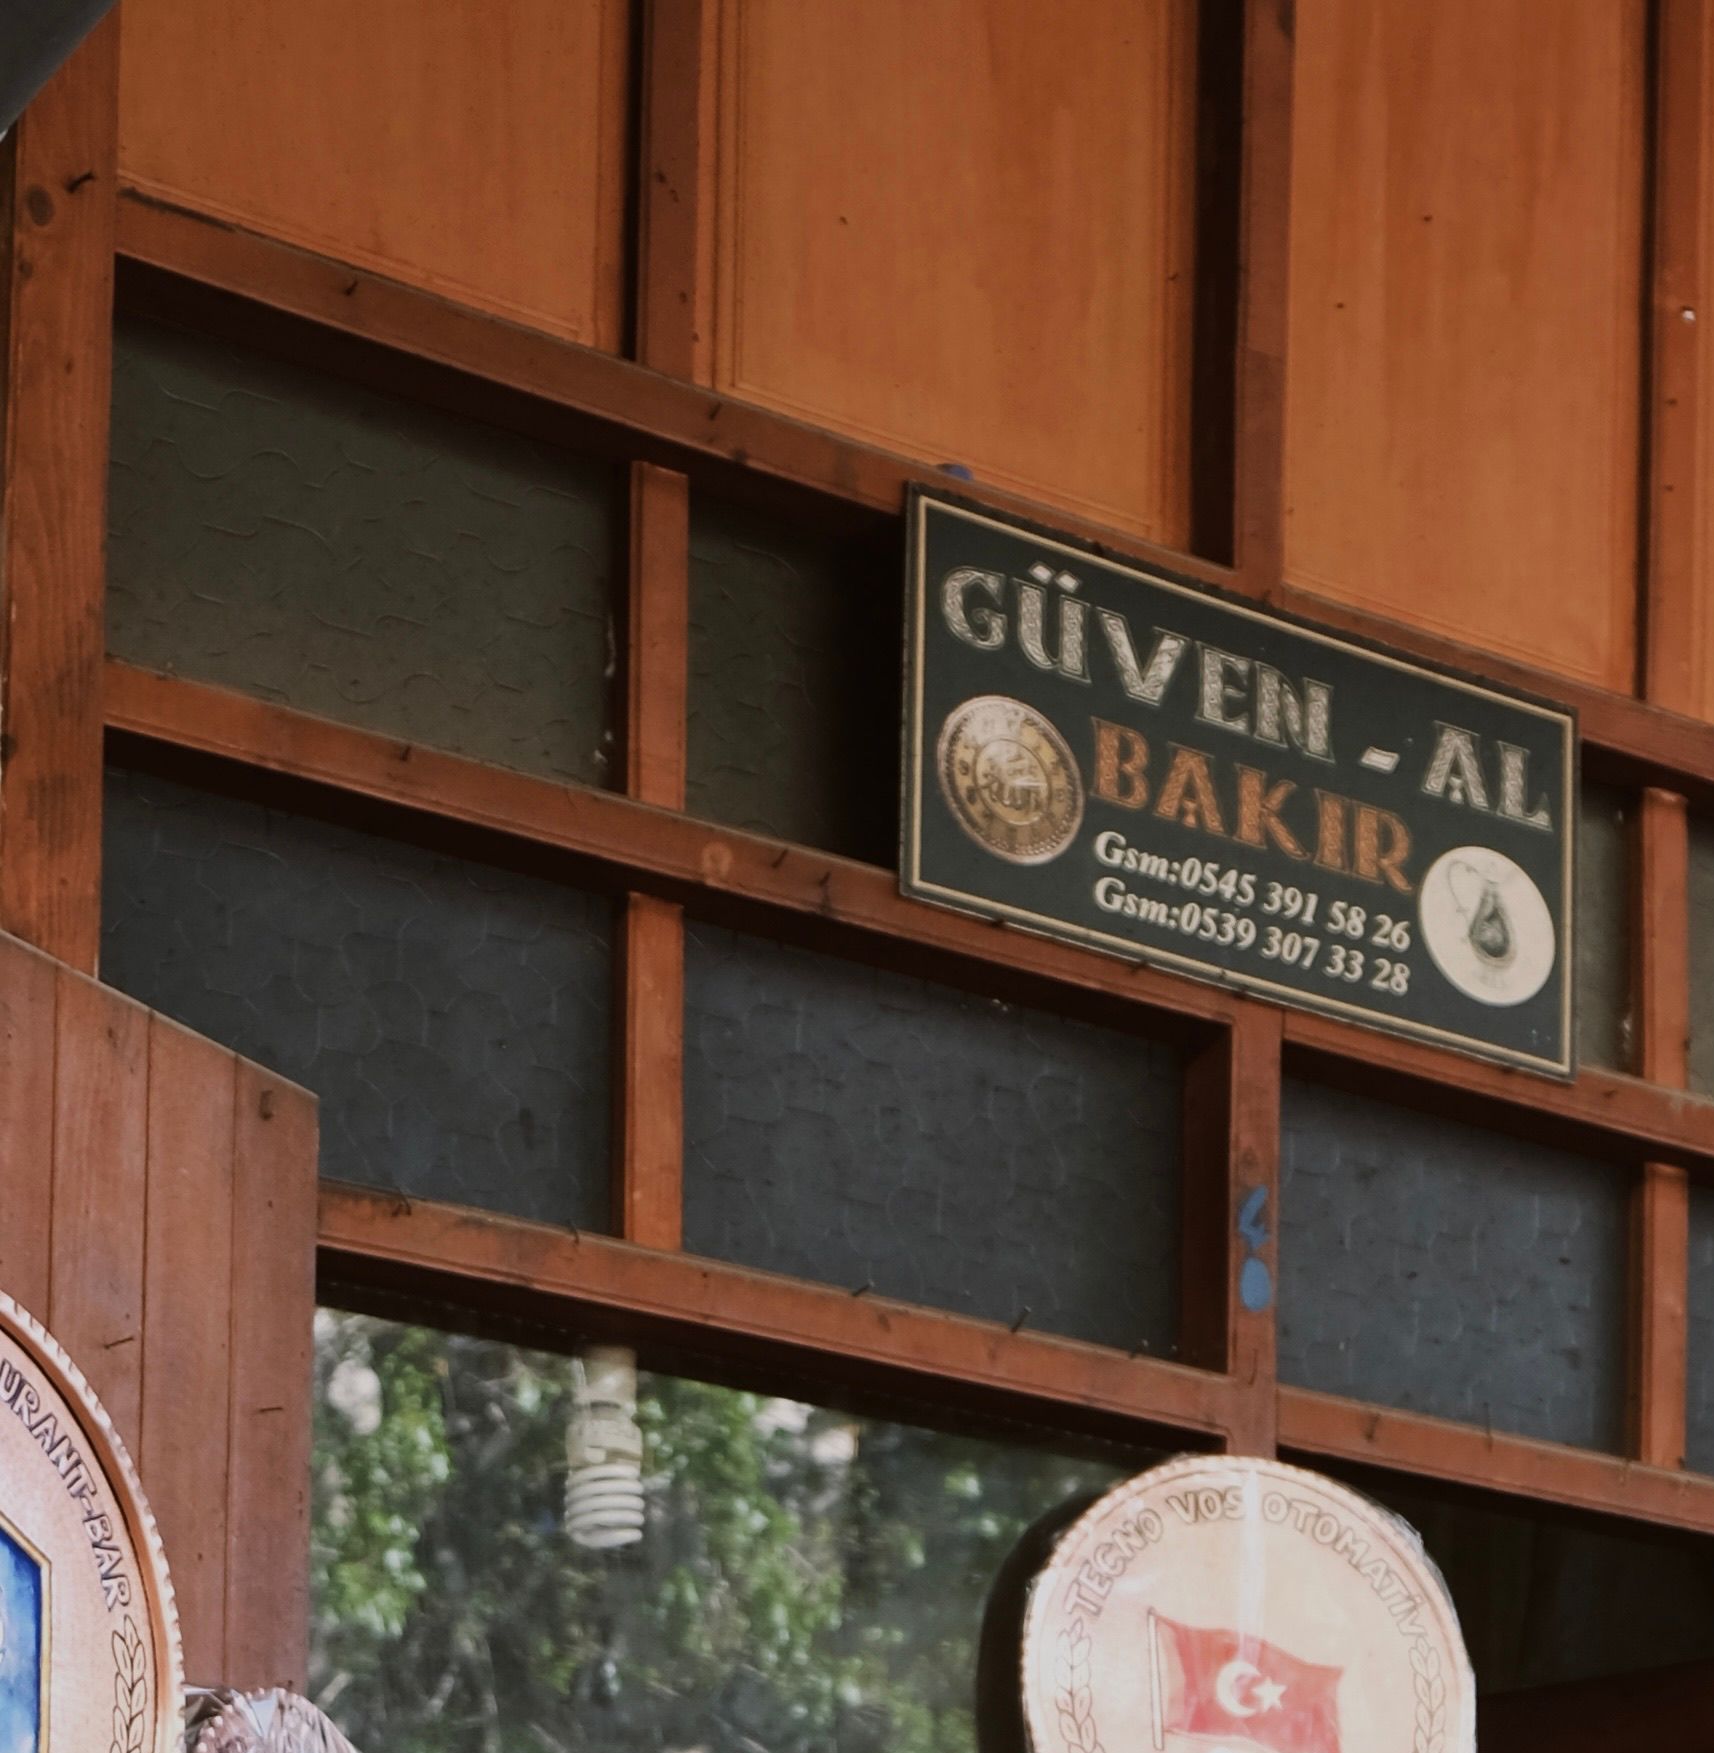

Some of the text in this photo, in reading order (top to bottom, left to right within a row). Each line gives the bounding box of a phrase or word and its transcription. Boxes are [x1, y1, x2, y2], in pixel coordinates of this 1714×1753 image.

[940, 561, 1336, 764] GÜVEN
[1419, 721, 1554, 832] AL
[1090, 716, 1415, 893] BAKIR
[1094, 830, 1410, 952] Gsm:0545 391 58 26
[1094, 876, 1409, 995] Gsm:0539 307 33 28
[1063, 1505, 1165, 1618] TECNO
